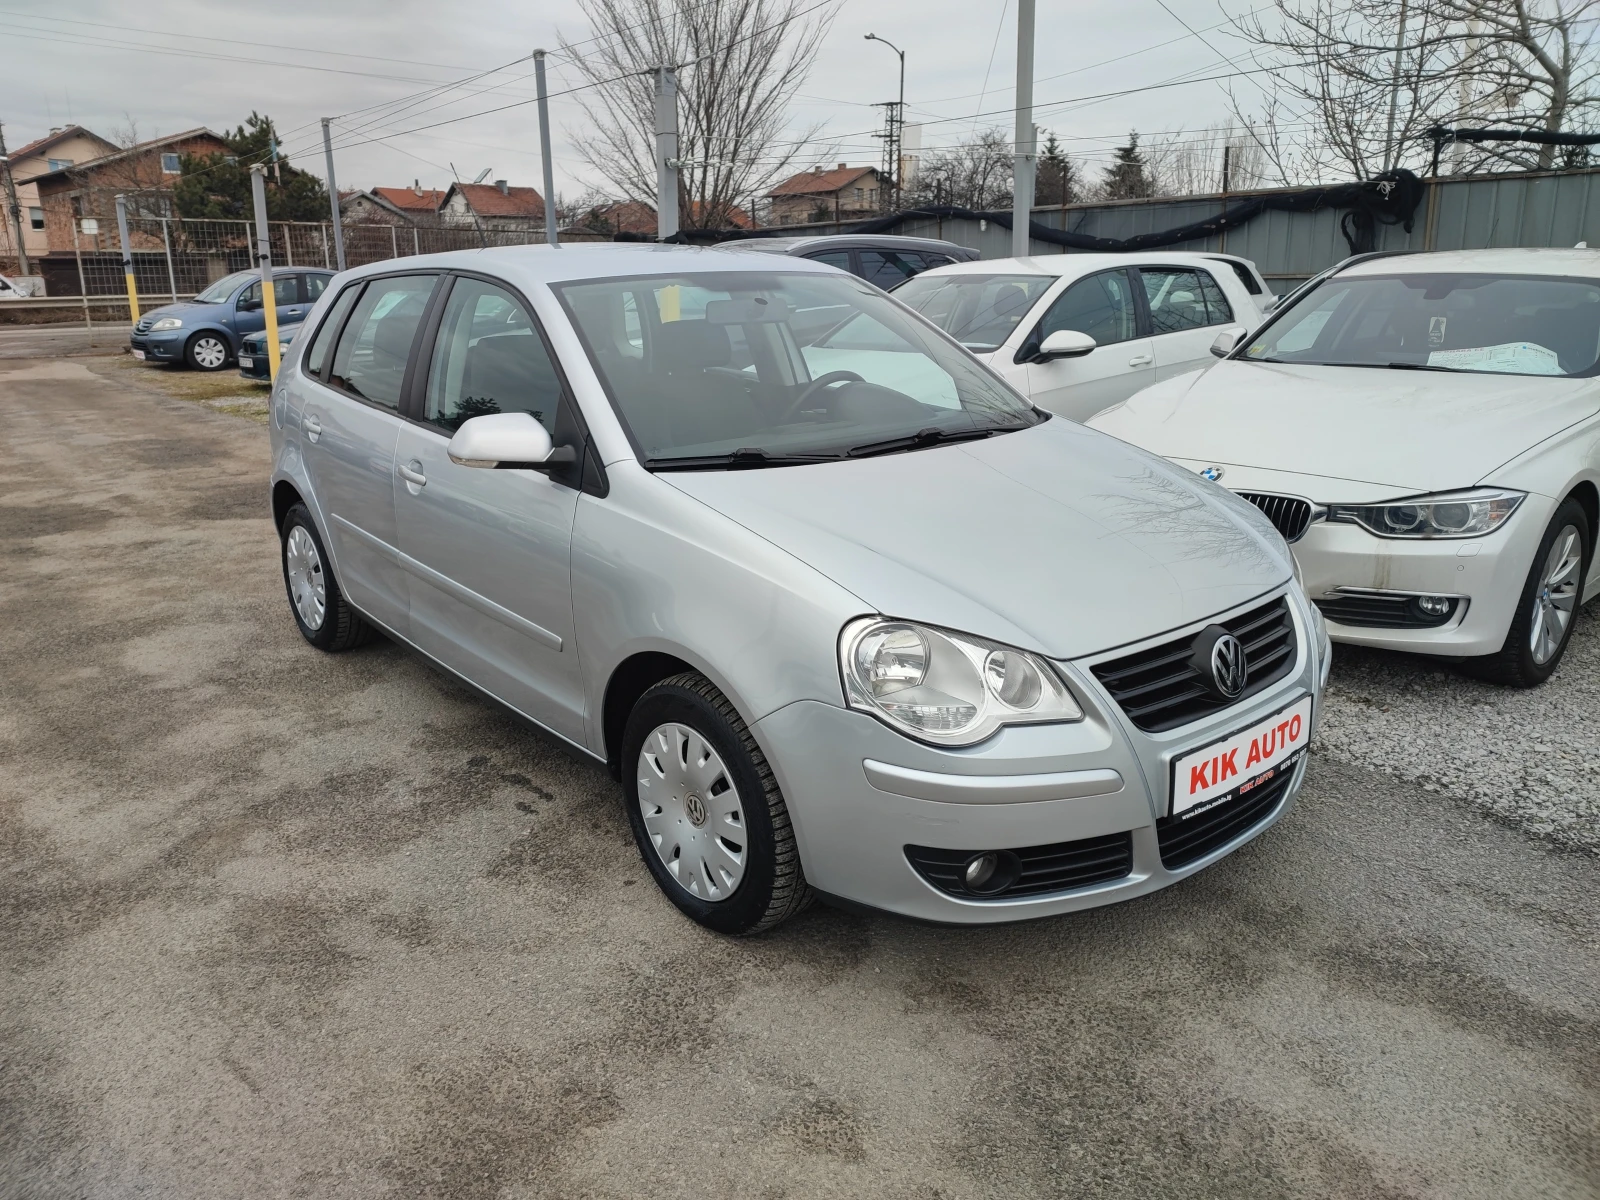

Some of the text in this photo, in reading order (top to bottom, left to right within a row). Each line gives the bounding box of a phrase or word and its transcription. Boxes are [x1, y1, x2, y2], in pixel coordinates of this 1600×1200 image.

[1189, 714, 1302, 795] KIK AUTO
[1240, 780, 1254, 795] KIK
[1254, 769, 1275, 787] AUTO
